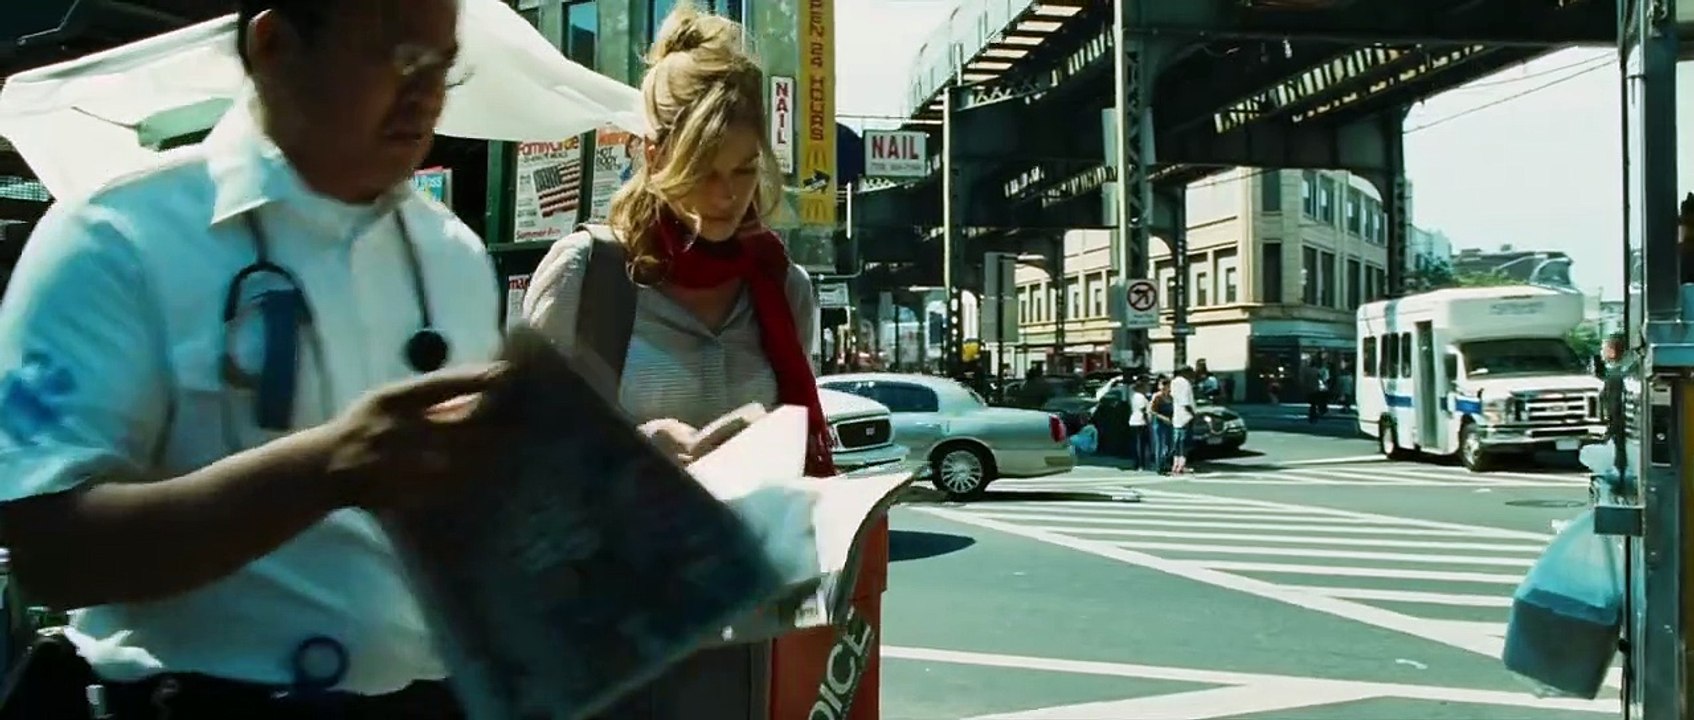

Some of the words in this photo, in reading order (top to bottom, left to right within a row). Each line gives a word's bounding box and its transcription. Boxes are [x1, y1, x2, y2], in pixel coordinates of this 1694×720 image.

[810, 42, 824, 68] 24
[776, 82, 789, 144] NAIL
[809, 75, 825, 141] HOURS
[871, 135, 919, 160] NAIL
